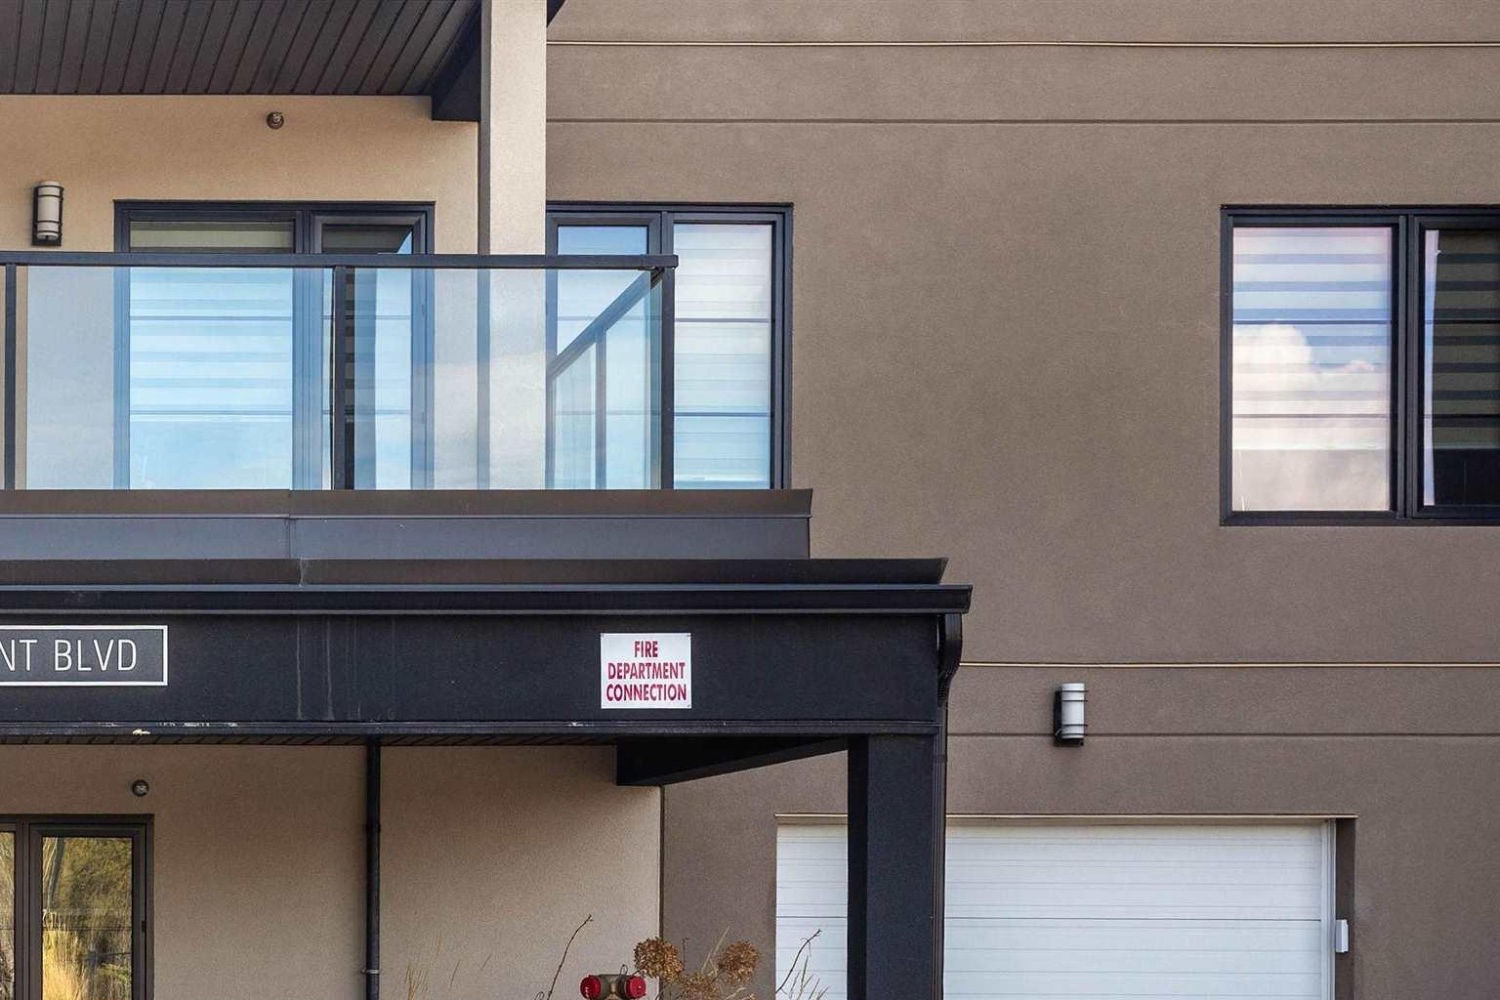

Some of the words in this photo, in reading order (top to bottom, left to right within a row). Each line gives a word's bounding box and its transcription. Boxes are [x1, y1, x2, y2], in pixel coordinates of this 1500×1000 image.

[53, 638, 138, 672] BLVD
[634, 640, 659, 658] FIRE
[607, 662, 686, 679] DEPARTMENT
[606, 683, 687, 702] CONNECTION
